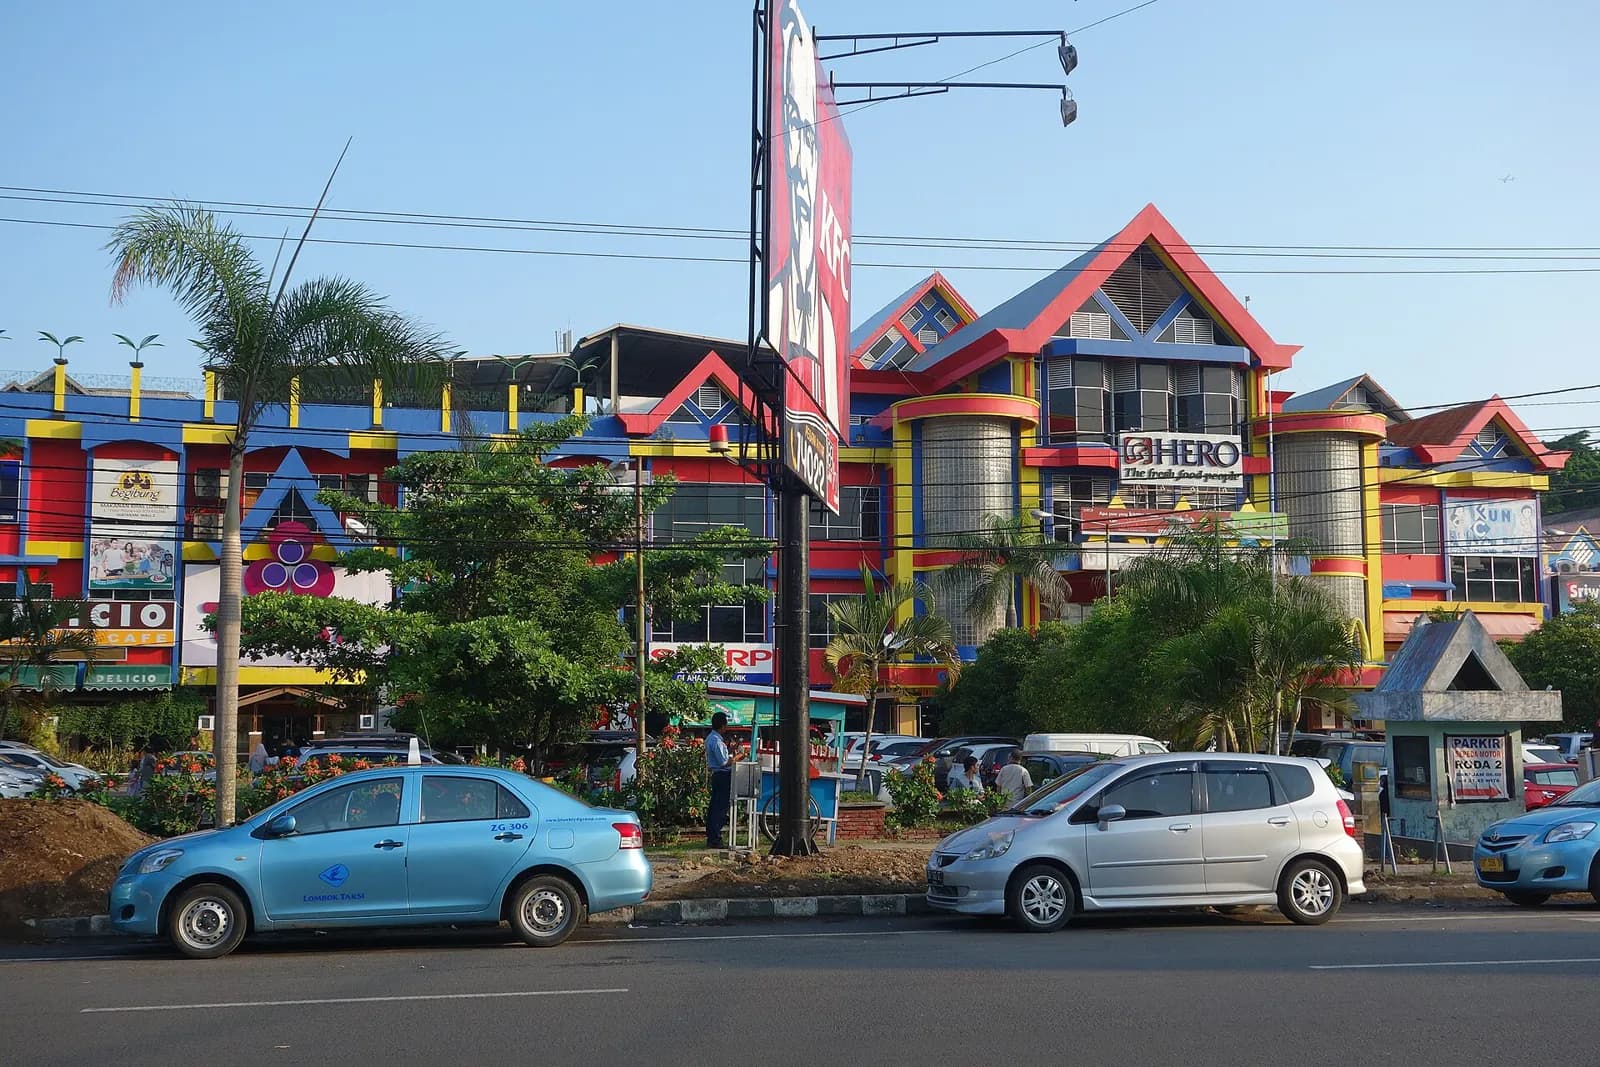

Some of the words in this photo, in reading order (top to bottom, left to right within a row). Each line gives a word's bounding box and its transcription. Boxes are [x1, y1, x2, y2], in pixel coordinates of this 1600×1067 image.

[819, 189, 850, 303] KFC
[1154, 438, 1240, 468] HERO
[796, 431, 825, 498] 14022
[1124, 467, 1146, 478] The
[1148, 468, 1175, 480] fresh
[1174, 469, 1203, 481] food
[1202, 471, 1241, 483] people
[110, 487, 160, 502] Begibung
[1475, 504, 1511, 523] FUN
[107, 633, 168, 643] CAFE
[650, 648, 772, 667] SRP
[96, 674, 157, 683] DELICIO
[1453, 738, 1500, 749] PARKIR
[1479, 750, 1502, 758] MOTOR
[1455, 760, 1491, 769] RODA
[1495, 760, 1502, 769] 2
[490, 823, 506, 832] ZG
[508, 822, 528, 831] 306
[303, 894, 338, 902] LOMBOK
[340, 892, 365, 901] TAKSI
